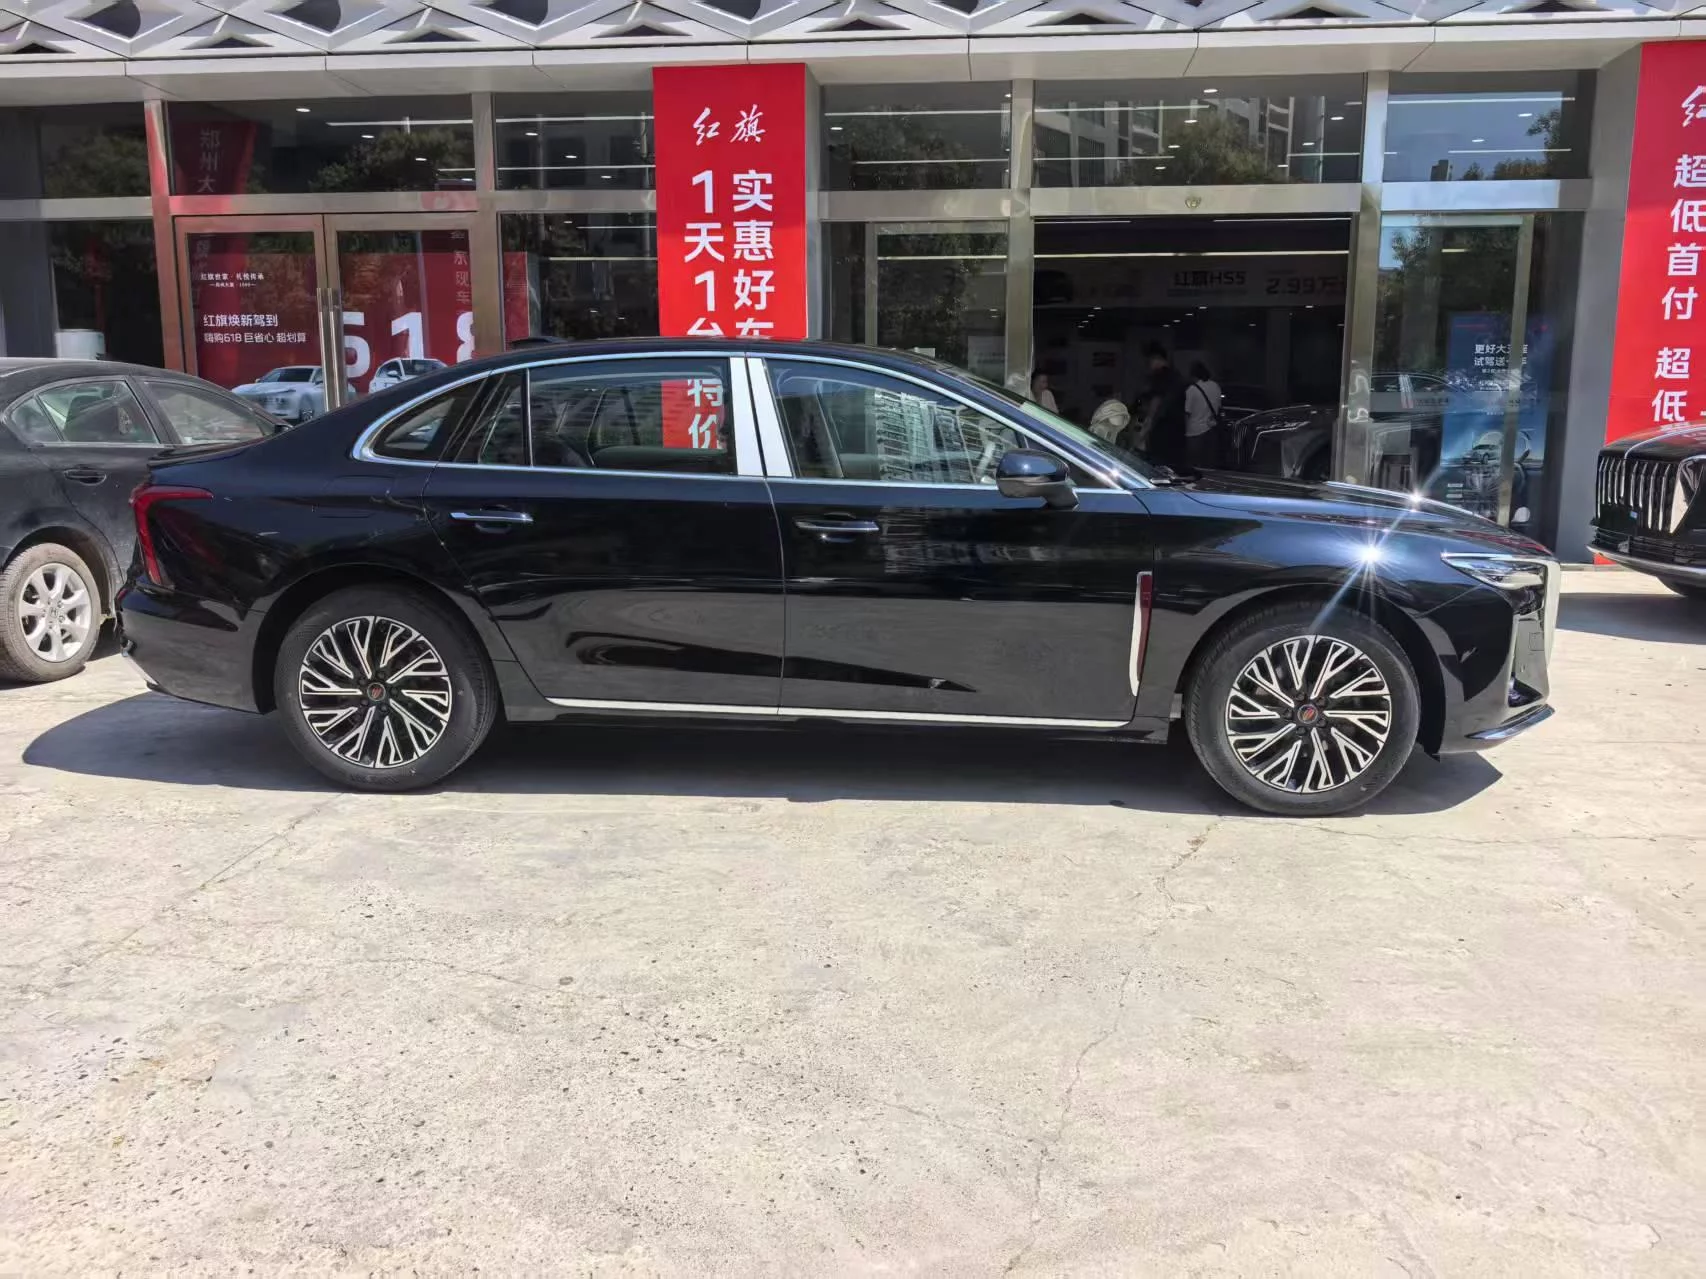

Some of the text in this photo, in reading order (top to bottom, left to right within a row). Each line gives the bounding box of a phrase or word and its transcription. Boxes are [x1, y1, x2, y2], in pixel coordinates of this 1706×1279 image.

[692, 103, 766, 146] 红旗
[203, 314, 278, 327] 红旗焕新驾到
